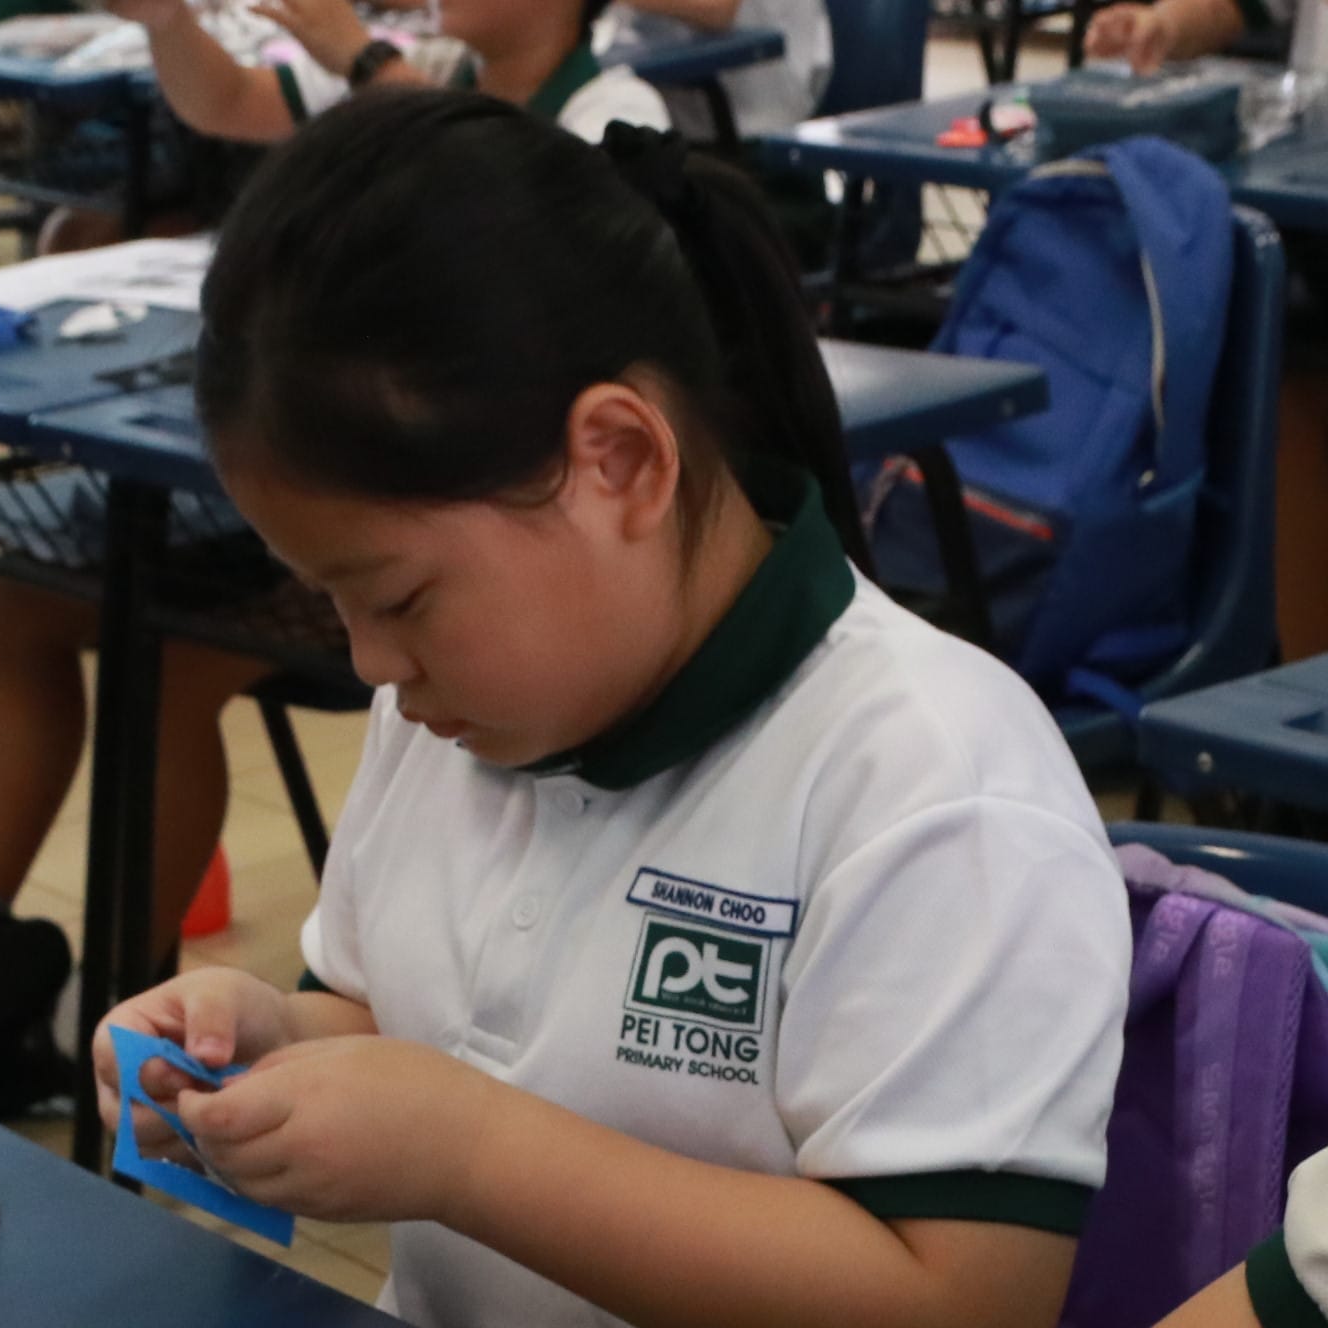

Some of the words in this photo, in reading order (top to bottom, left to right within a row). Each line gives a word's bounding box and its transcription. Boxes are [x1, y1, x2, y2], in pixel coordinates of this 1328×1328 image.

[650, 880, 715, 913] SHANNON
[719, 899, 767, 925] CHOO
[620, 1015, 661, 1046] PEI
[673, 1024, 760, 1063] TONG
[616, 1046, 684, 1074] PRIMARY
[688, 1060, 760, 1085] SCHOOL
